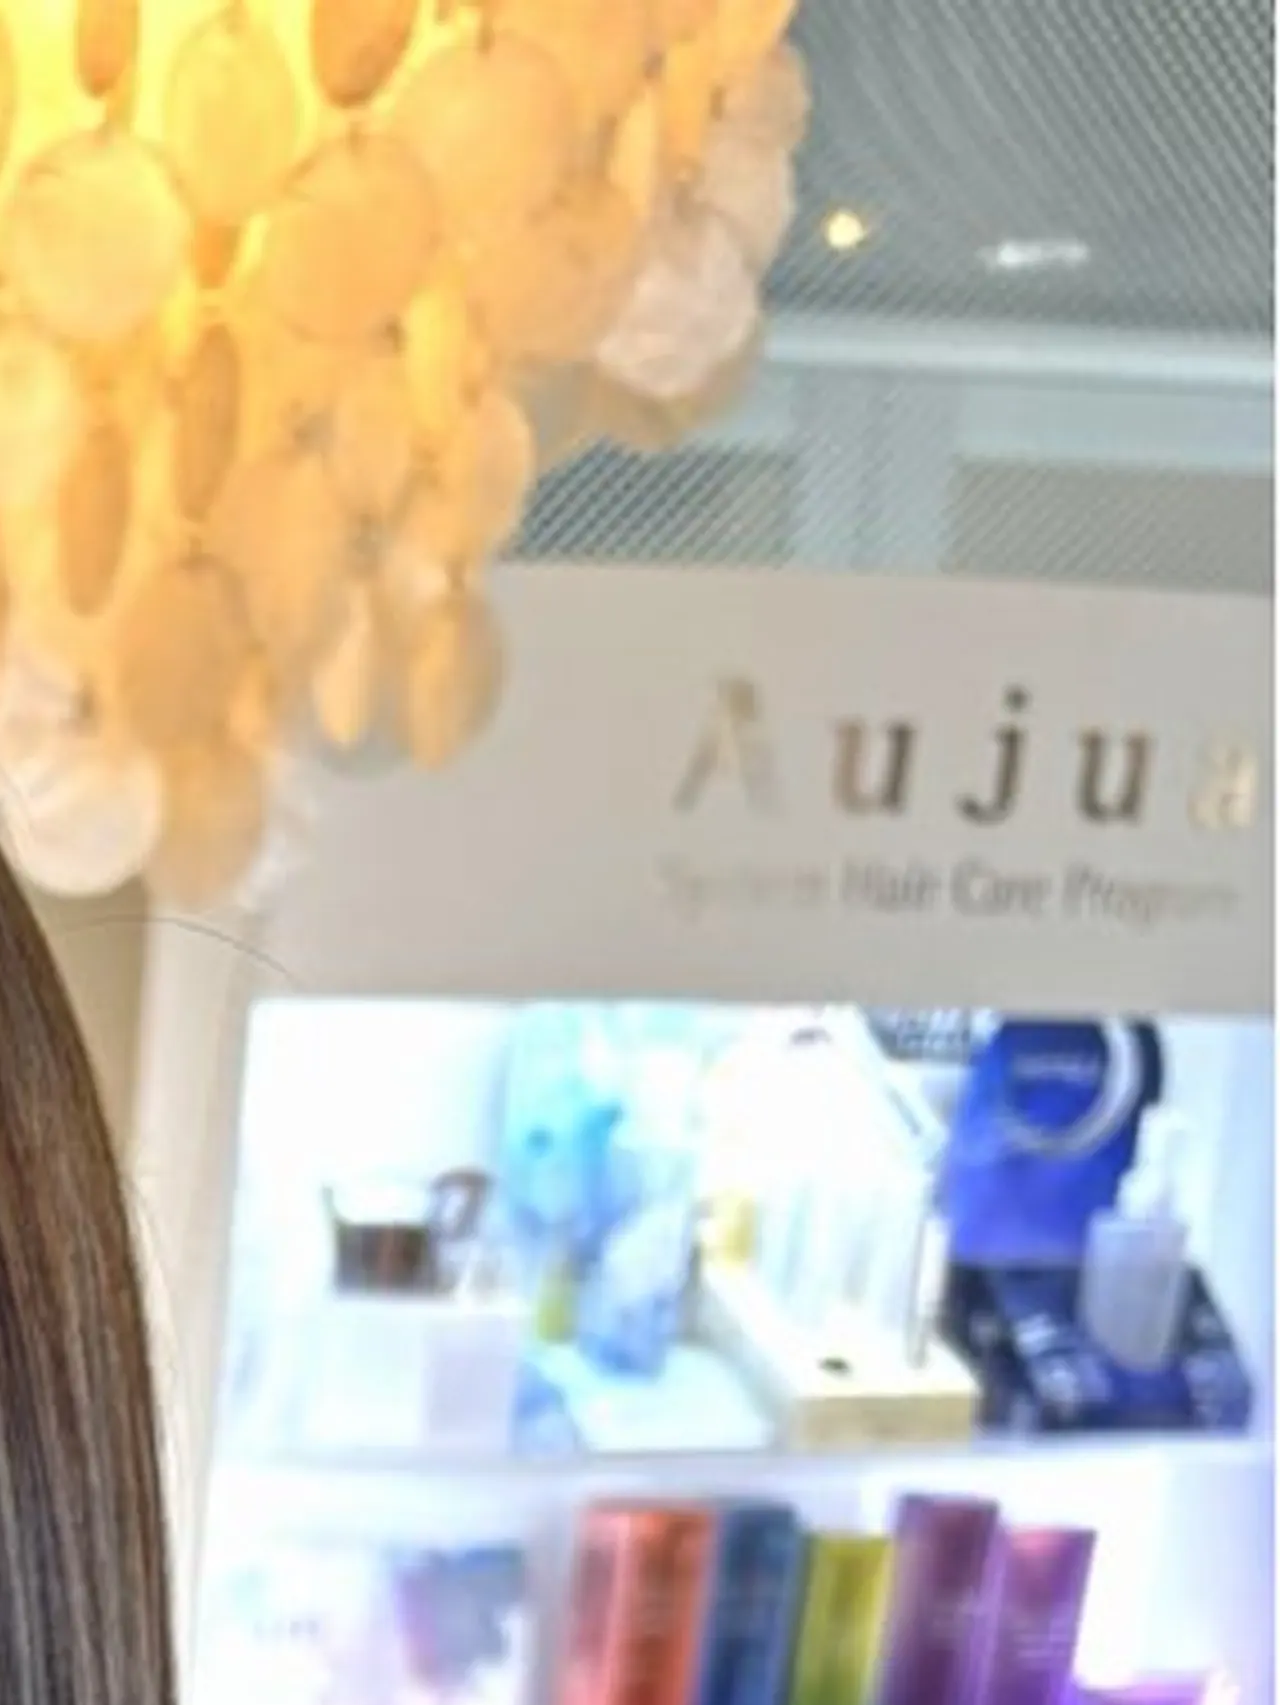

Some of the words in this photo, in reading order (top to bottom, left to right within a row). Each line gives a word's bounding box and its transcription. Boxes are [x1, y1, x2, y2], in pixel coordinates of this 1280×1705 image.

[670, 674, 1260, 830] Aujua
[840, 855, 941, 913] Hair
[949, 855, 1054, 919] Care
